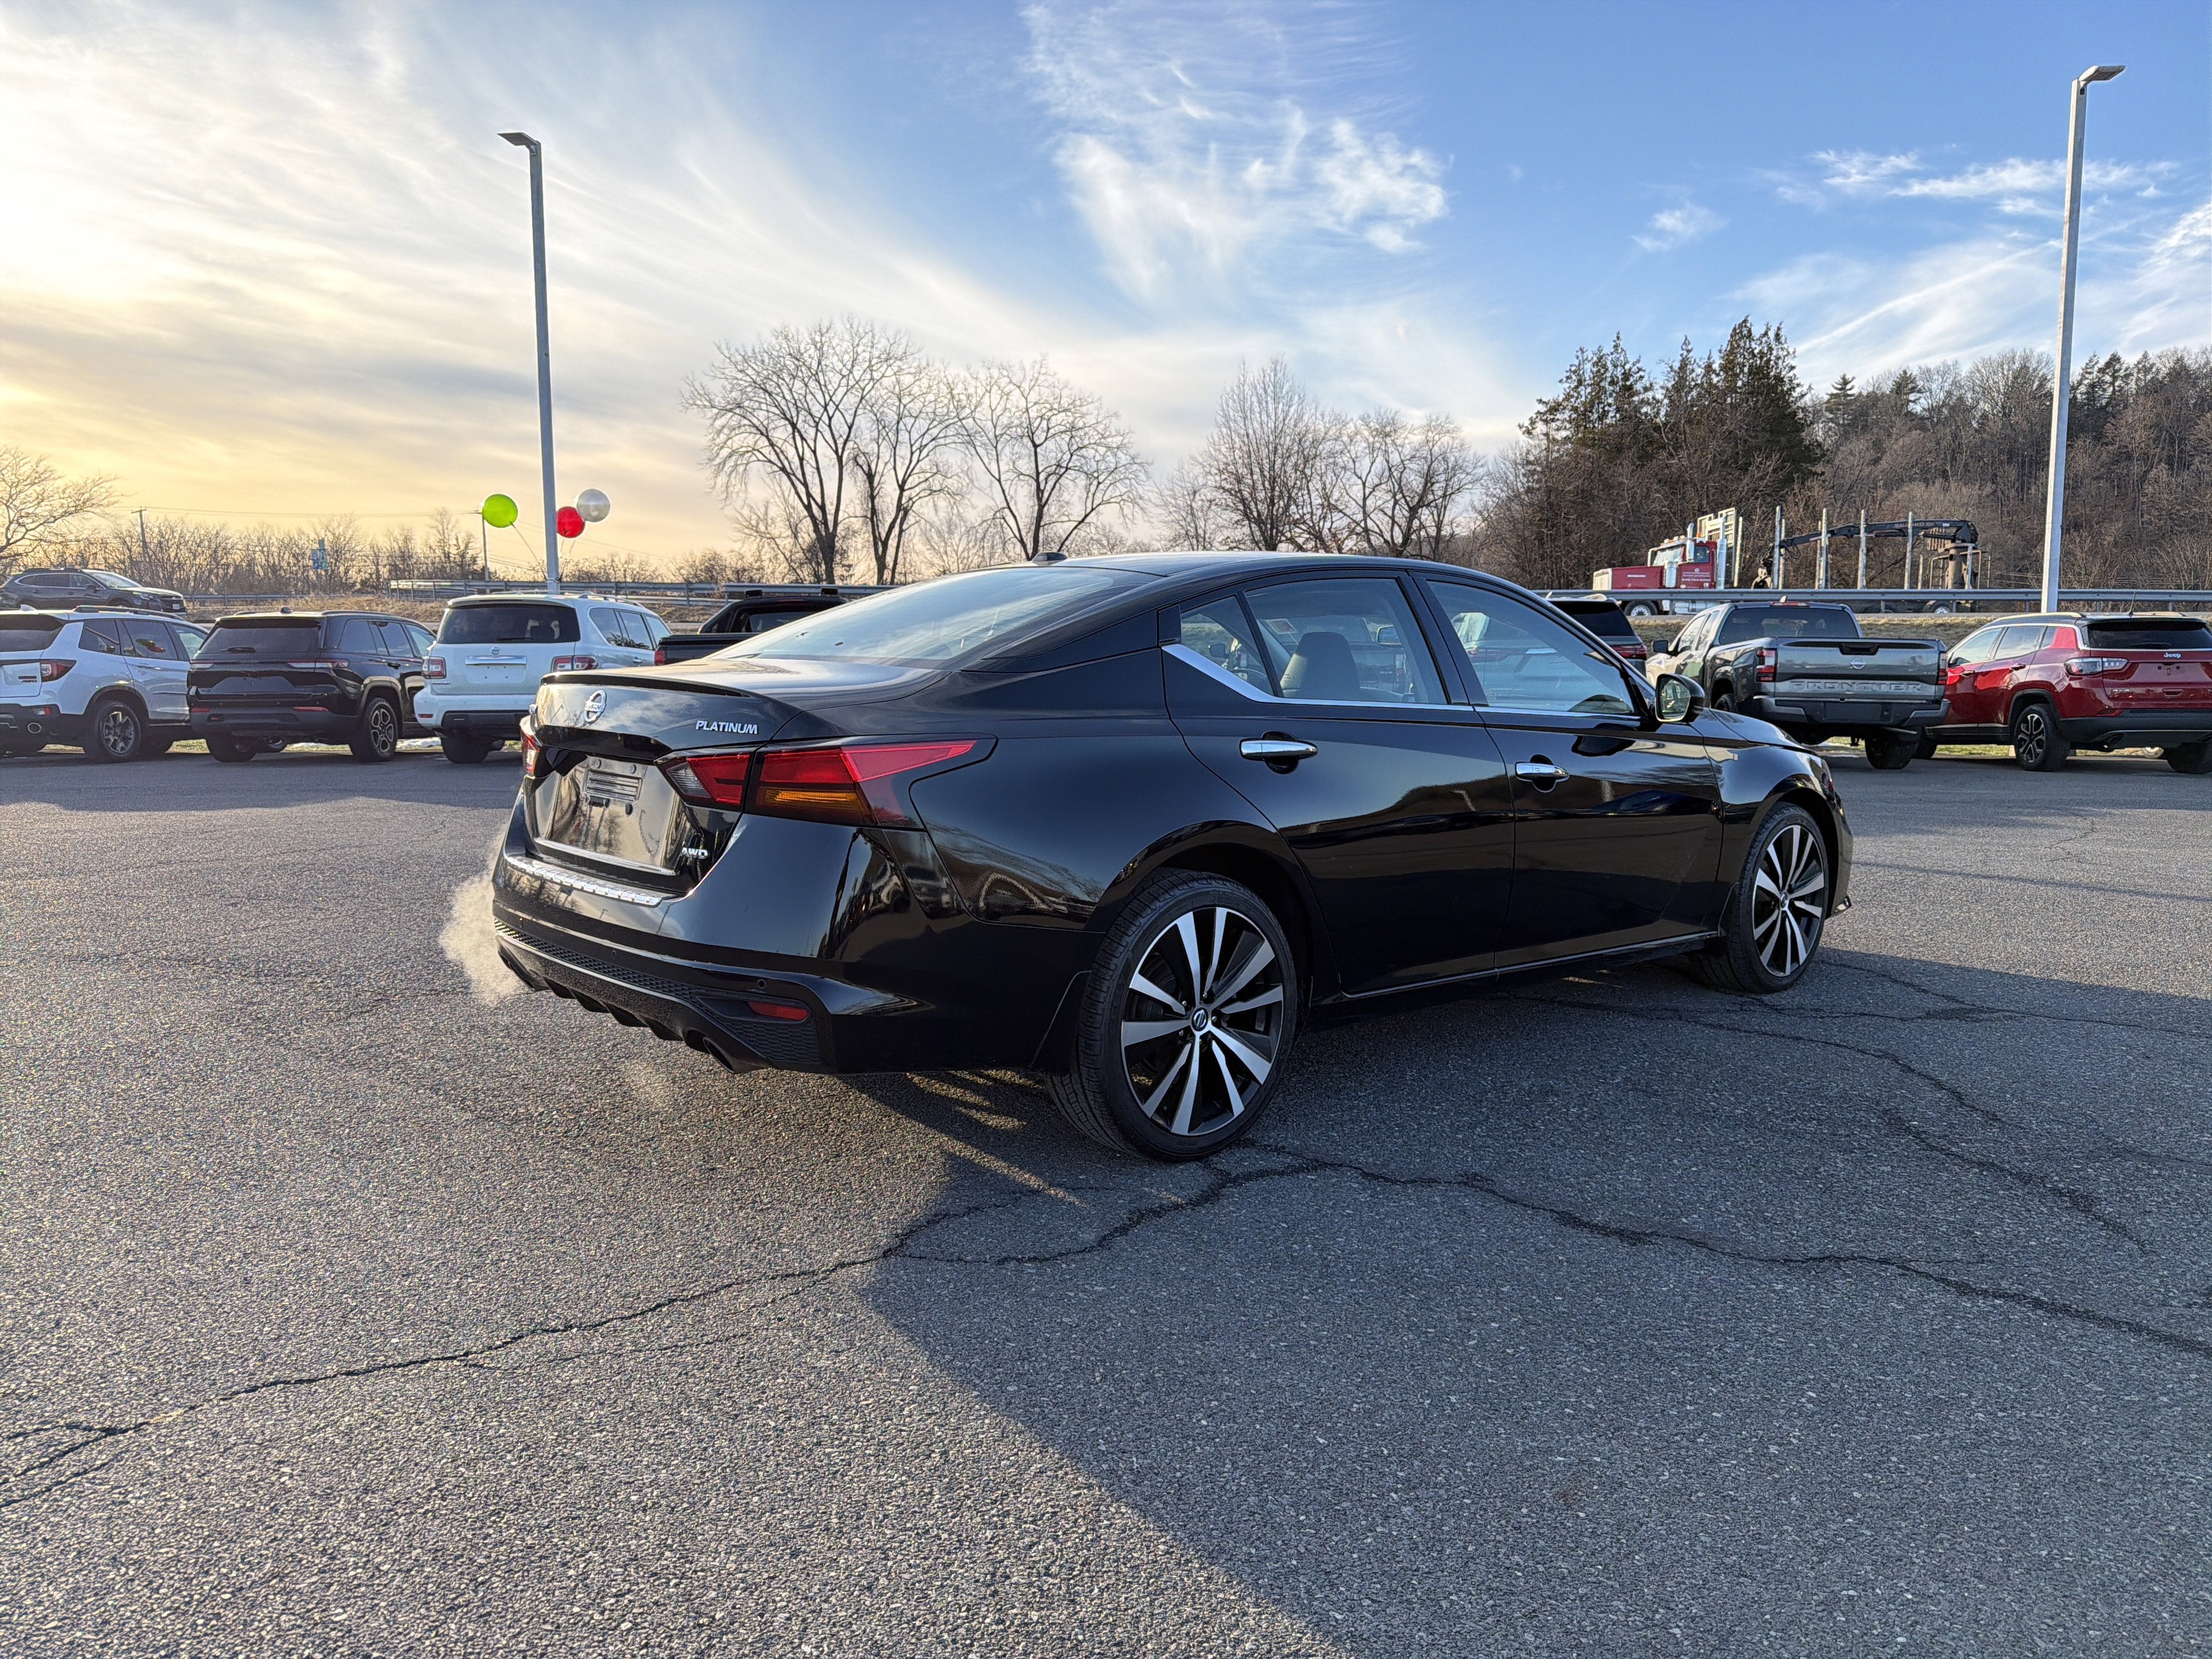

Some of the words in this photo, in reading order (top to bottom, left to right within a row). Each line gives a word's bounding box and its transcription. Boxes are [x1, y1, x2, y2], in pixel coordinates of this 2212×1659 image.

[1790, 680, 1922, 692] FRONTIER
[695, 720, 758, 735] PLATINUM
[680, 847, 708, 859] AWD
